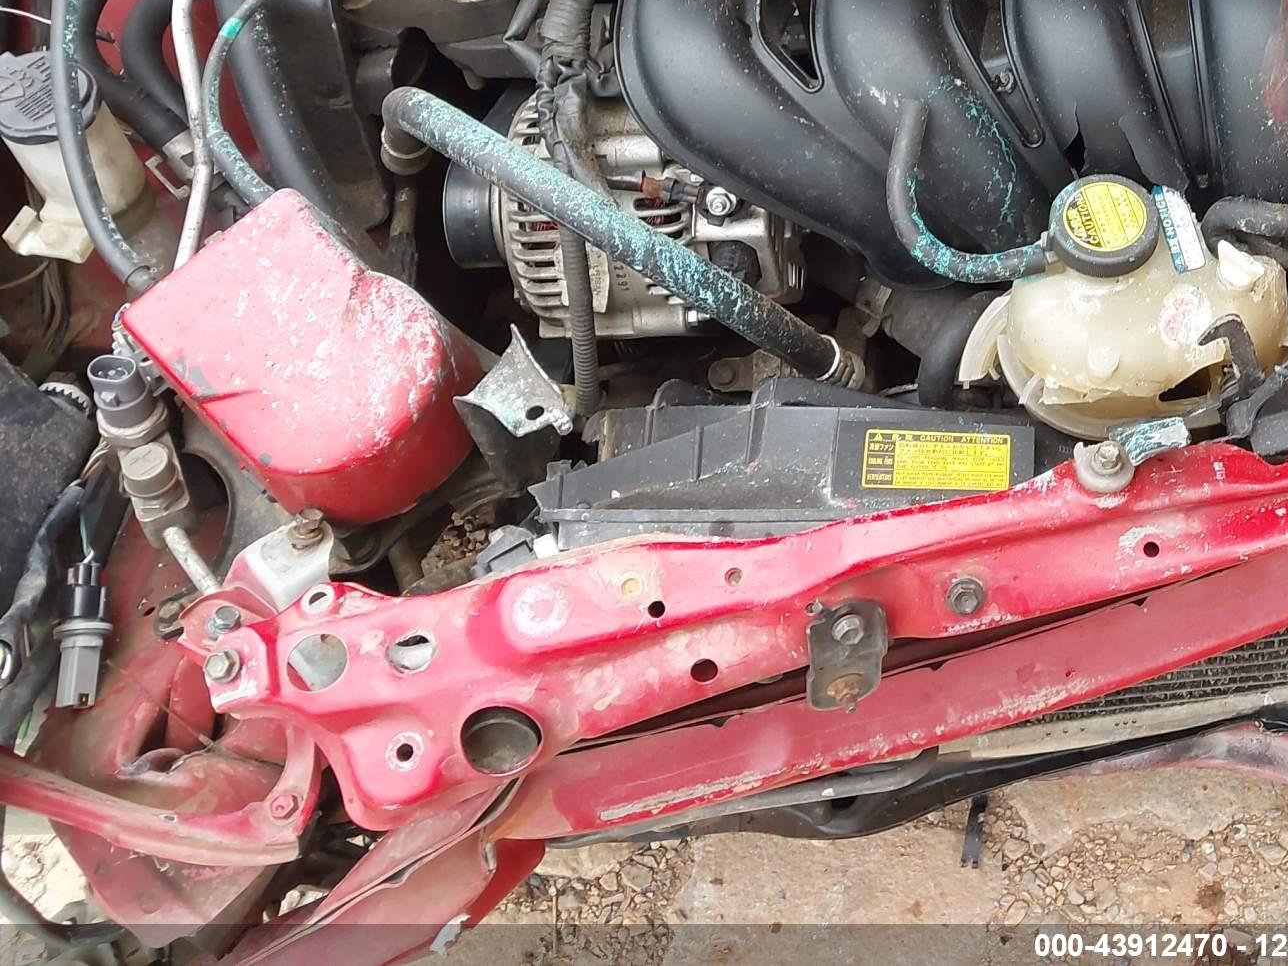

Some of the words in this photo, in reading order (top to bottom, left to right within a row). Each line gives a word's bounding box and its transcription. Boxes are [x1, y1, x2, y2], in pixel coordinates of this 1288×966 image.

[1073, 191, 1100, 244] CAUTION
[1154, 193, 1178, 240] NOTICE
[919, 434, 955, 443] CAUTION
[960, 436, 1004, 445] ATTENTION
